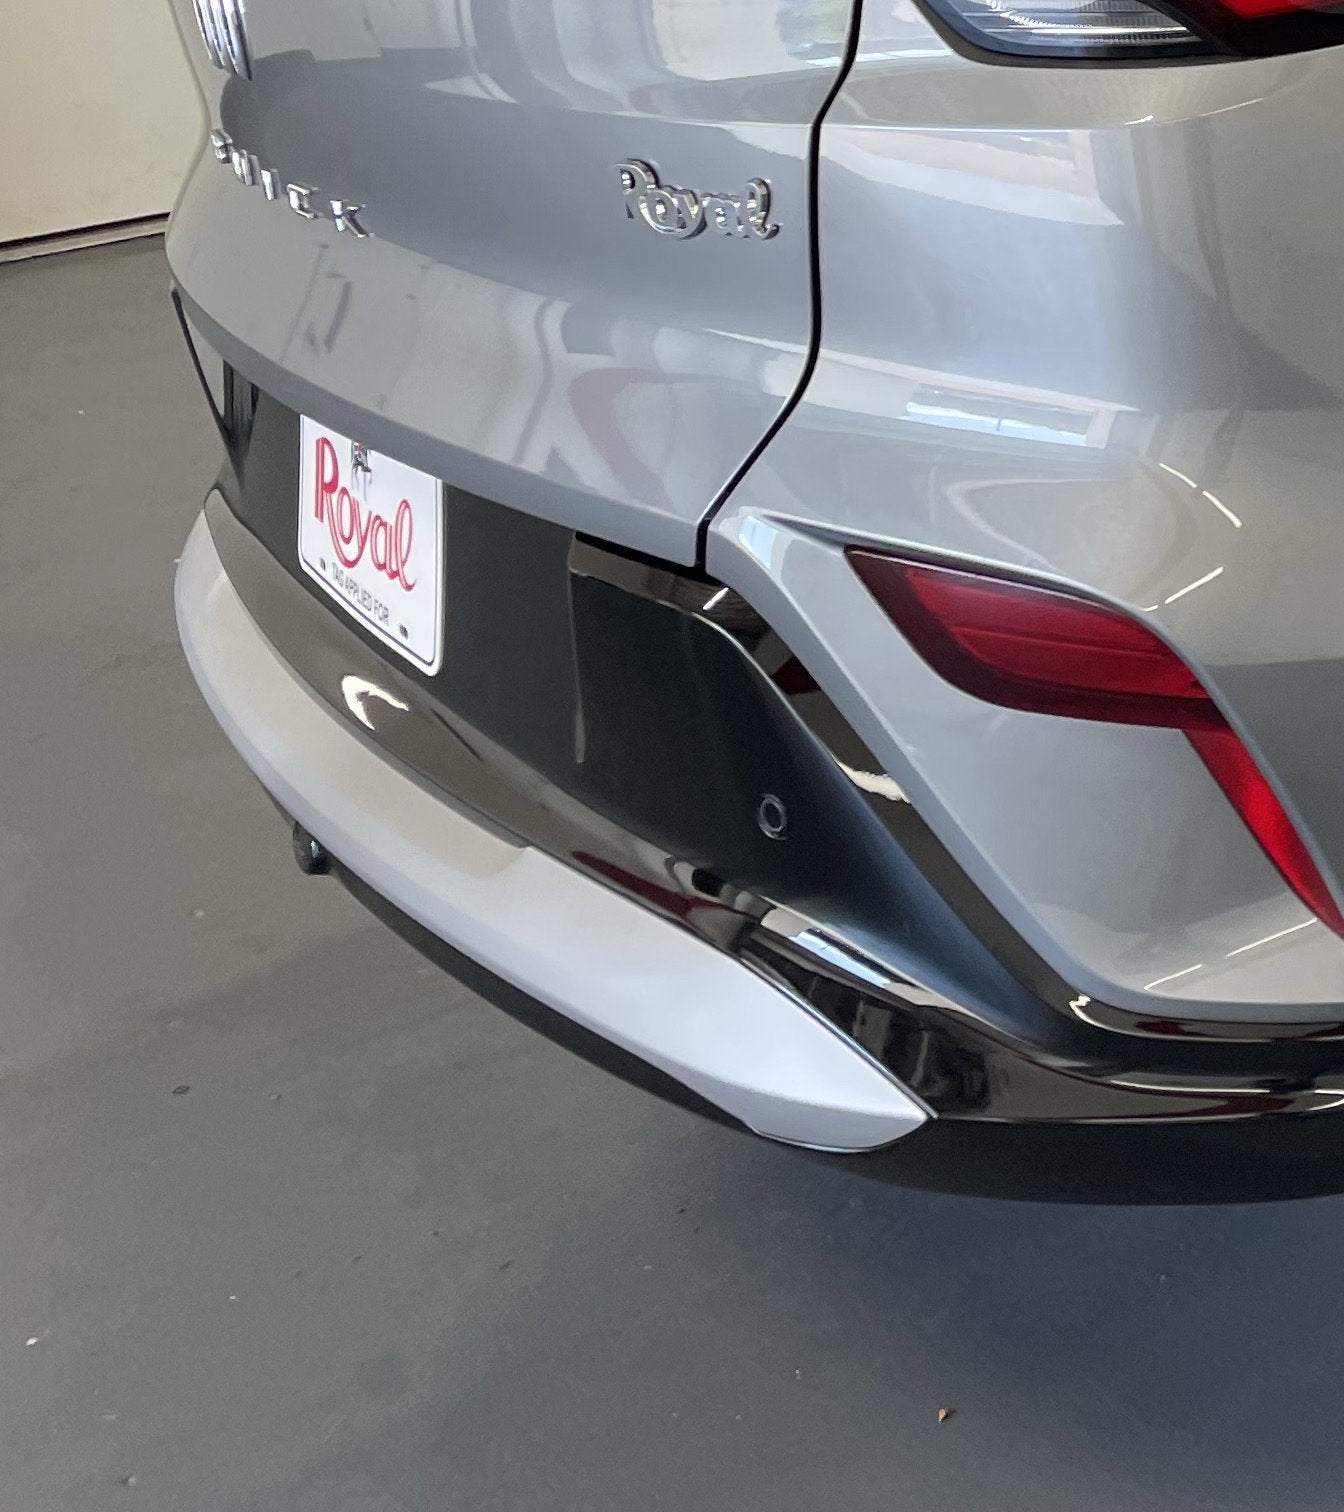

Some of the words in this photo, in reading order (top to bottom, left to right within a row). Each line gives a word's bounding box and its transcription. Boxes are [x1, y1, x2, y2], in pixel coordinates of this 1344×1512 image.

[209, 128, 376, 239] BUICK
[613, 157, 782, 240] Royal
[314, 436, 417, 592] Royal
